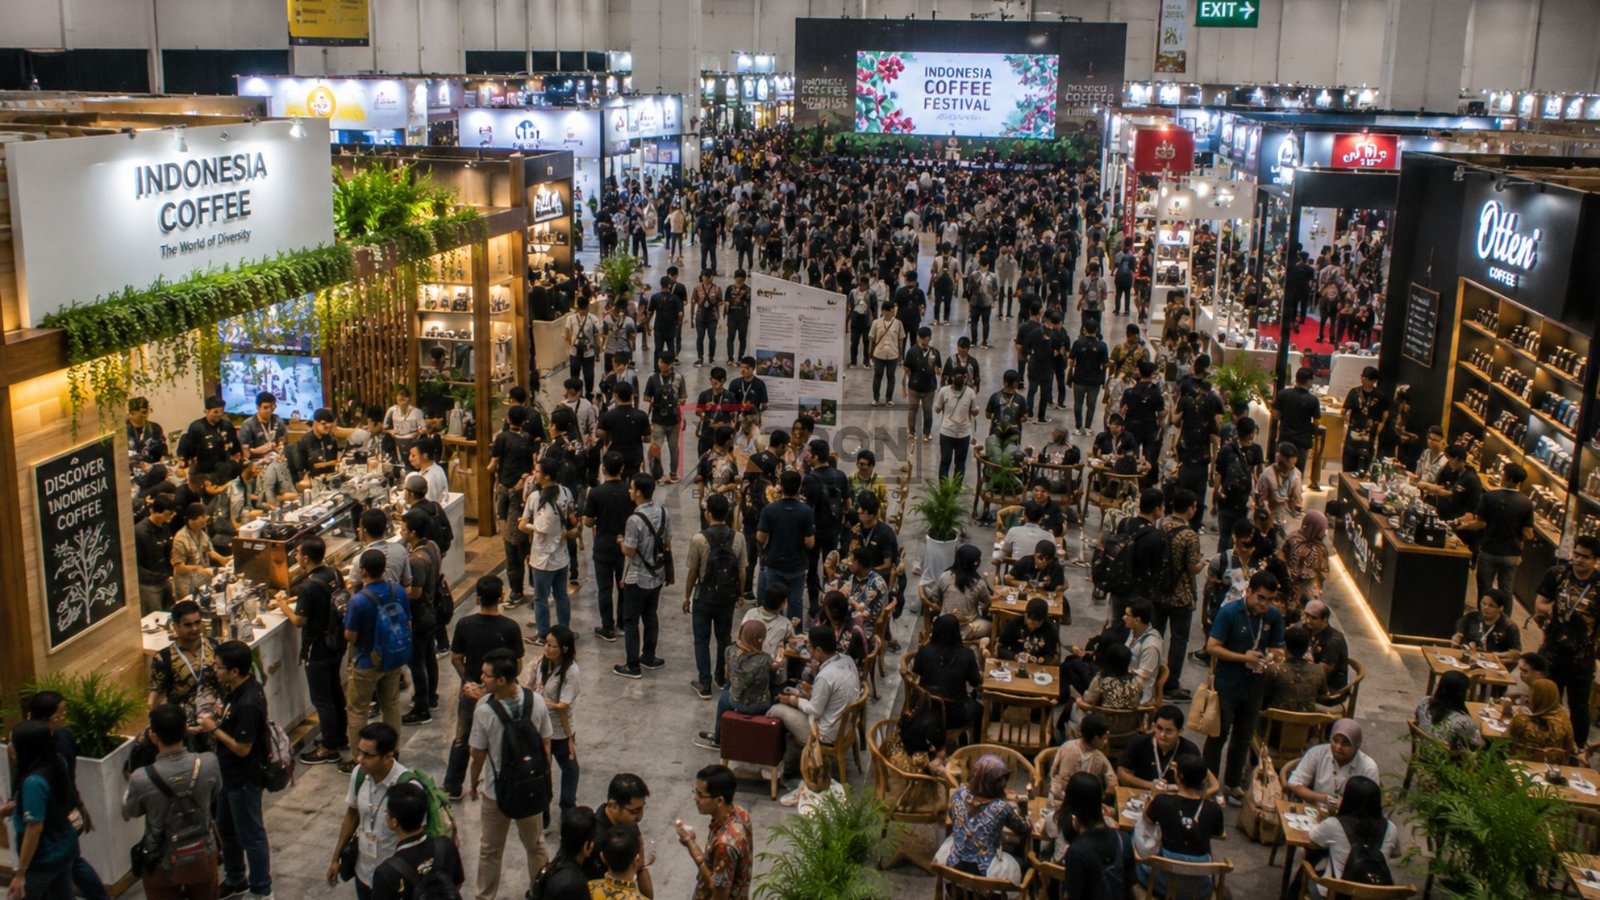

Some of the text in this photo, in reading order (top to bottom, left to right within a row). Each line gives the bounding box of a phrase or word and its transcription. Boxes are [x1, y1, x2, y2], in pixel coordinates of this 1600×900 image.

[1201, 2, 1237, 17] EXIT
[924, 80, 992, 96] COFFEE
[925, 66, 992, 79] INDONESIA
[924, 98, 991, 111] FESTIVAL
[135, 152, 267, 197] INDONESIA
[159, 190, 251, 232] COFFEE
[160, 229, 251, 259] The World of Diversity
[1478, 200, 1540, 270] Otten
[1488, 266, 1519, 288] COFFEE
[44, 457, 106, 496] DISCOVER
[48, 476, 108, 515] INDONESIA
[57, 499, 103, 531] COFFEE
